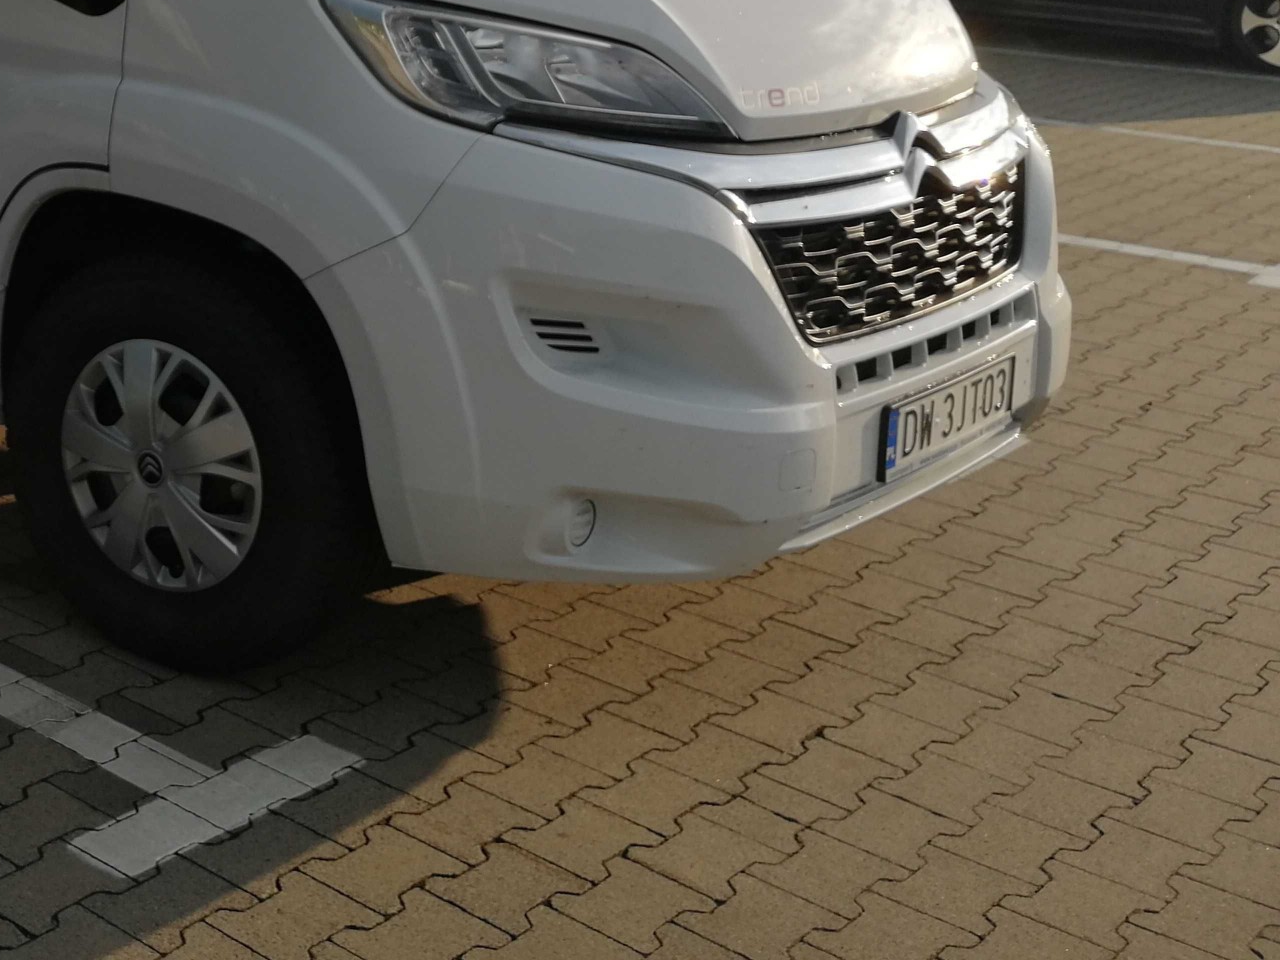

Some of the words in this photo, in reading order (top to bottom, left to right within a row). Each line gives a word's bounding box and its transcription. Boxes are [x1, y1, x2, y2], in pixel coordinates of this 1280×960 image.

[739, 81, 820, 110] trend
[902, 400, 935, 458] DW
[942, 368, 1007, 438] 3JT03
